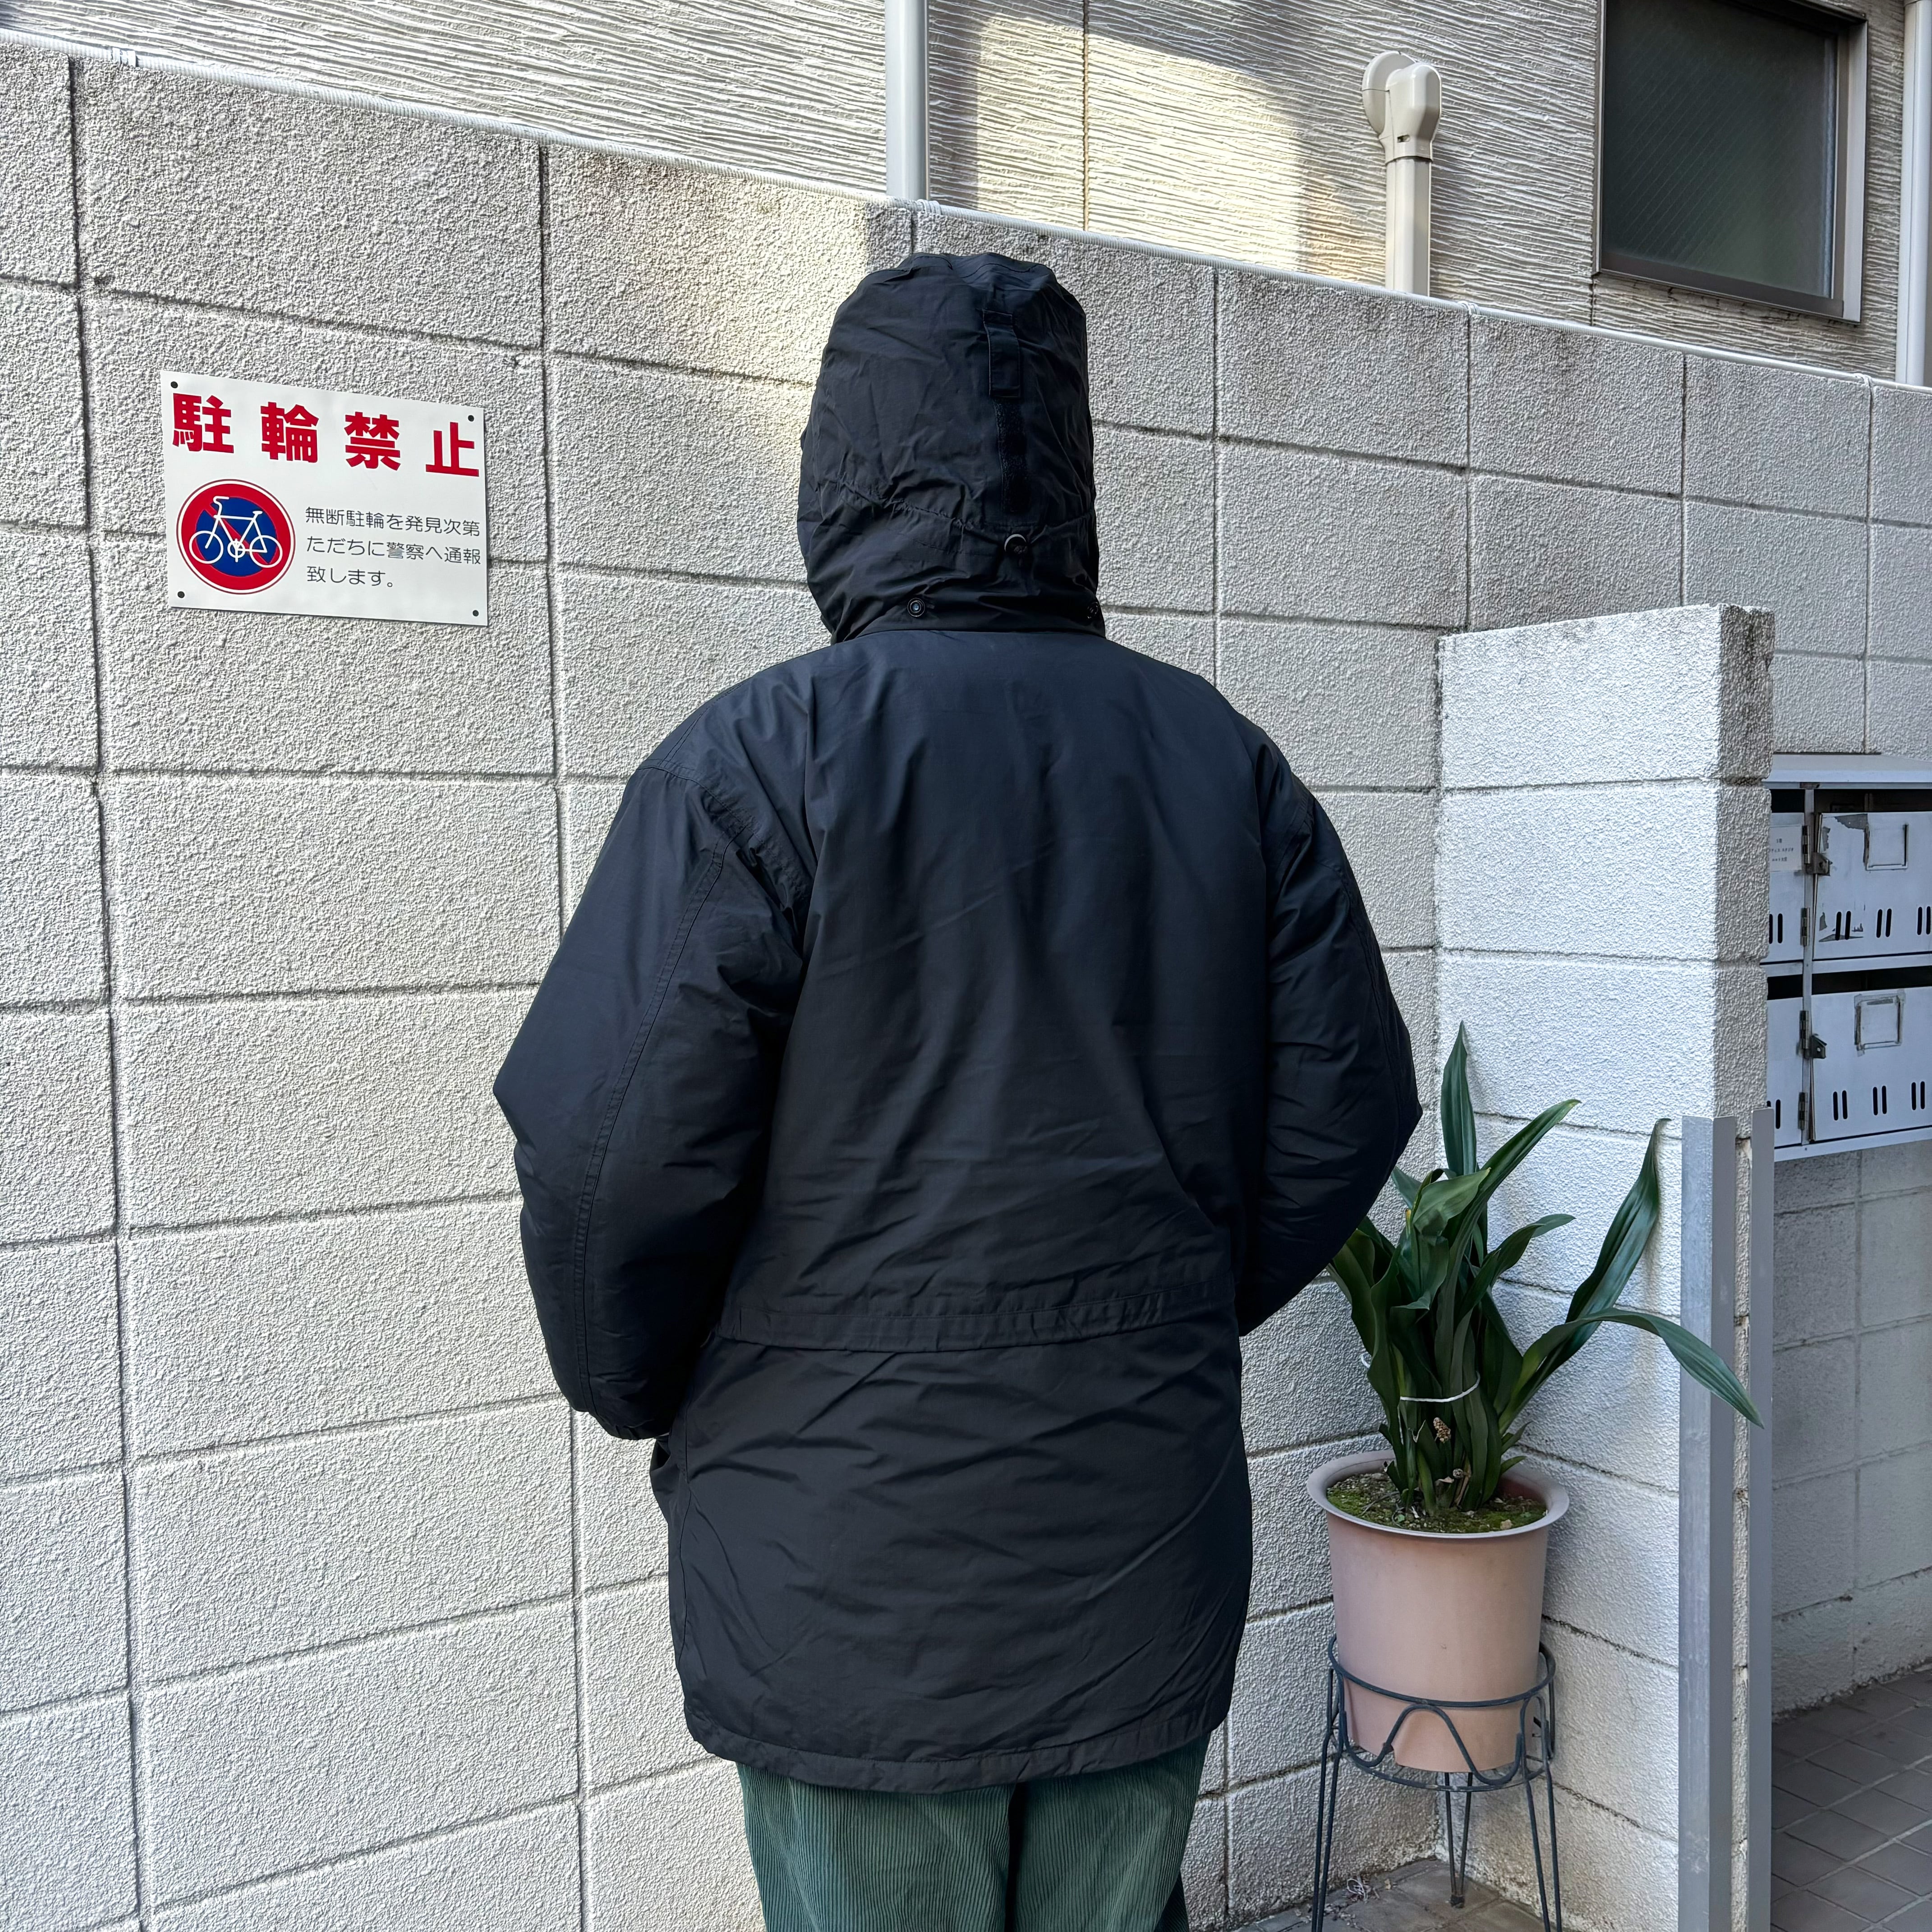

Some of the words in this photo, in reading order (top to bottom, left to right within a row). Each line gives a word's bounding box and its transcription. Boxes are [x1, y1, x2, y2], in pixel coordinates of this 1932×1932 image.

[173, 393, 479, 477] 駐輪禁止
[305, 506, 480, 536] 無断駐輪を発見次第
[307, 536, 481, 565] ただちに警察へ通報
[307, 566, 393, 588] 致します。
